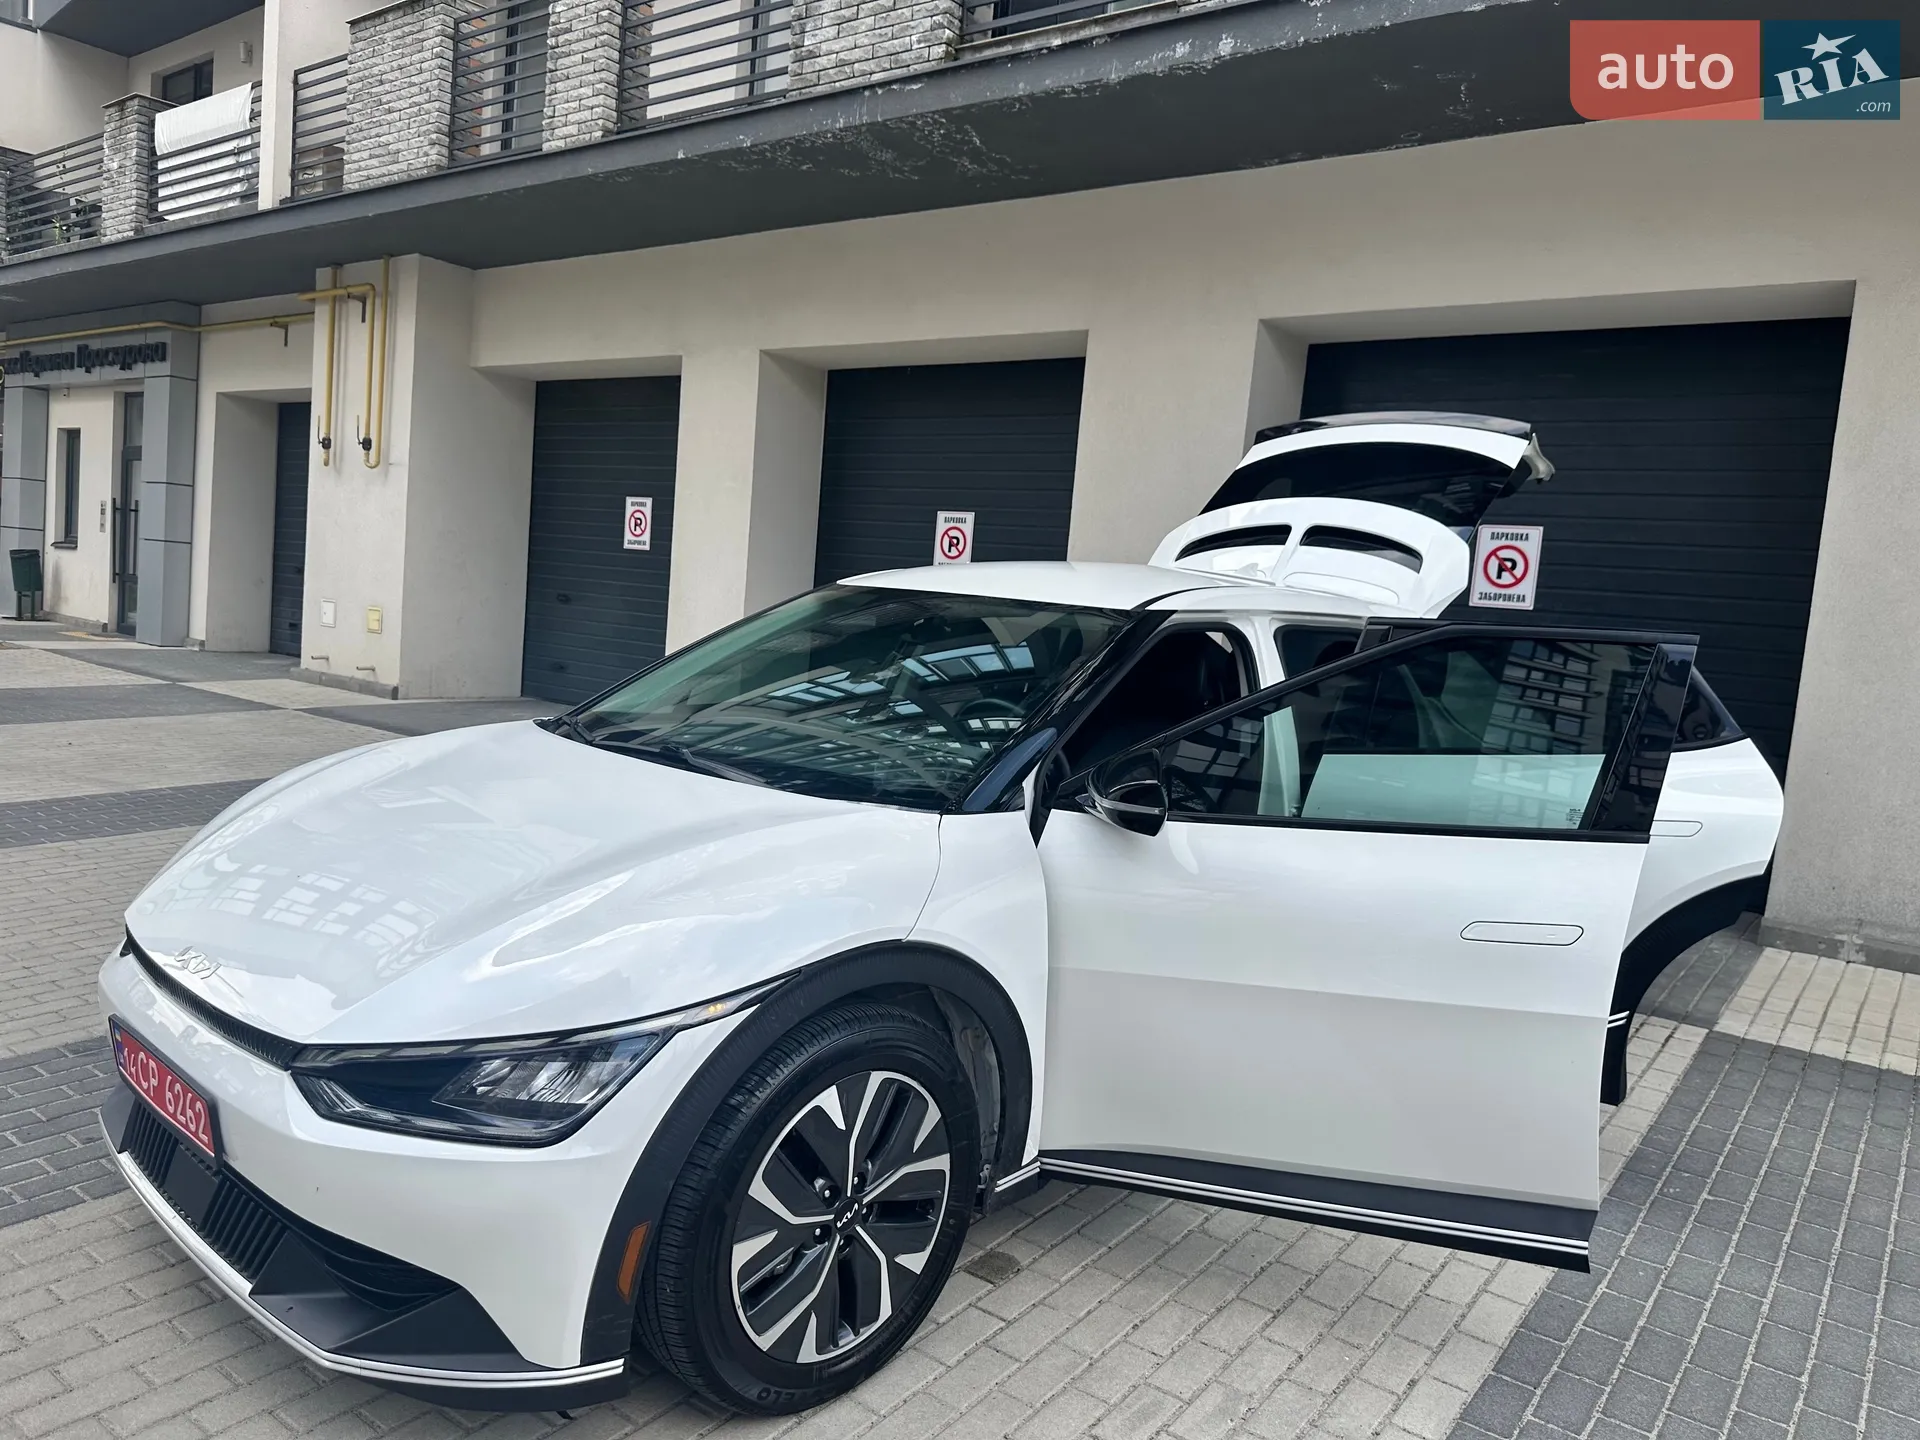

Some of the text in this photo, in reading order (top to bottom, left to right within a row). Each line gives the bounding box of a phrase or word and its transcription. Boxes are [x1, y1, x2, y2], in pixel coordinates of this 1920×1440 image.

[944, 516, 967, 524] ПАРКОВКА
[1490, 531, 1530, 542] ПАРКОВКА
[1477, 591, 1527, 603] ЗАБОРОНЕНА
[165, 1075, 209, 1145] 6262
